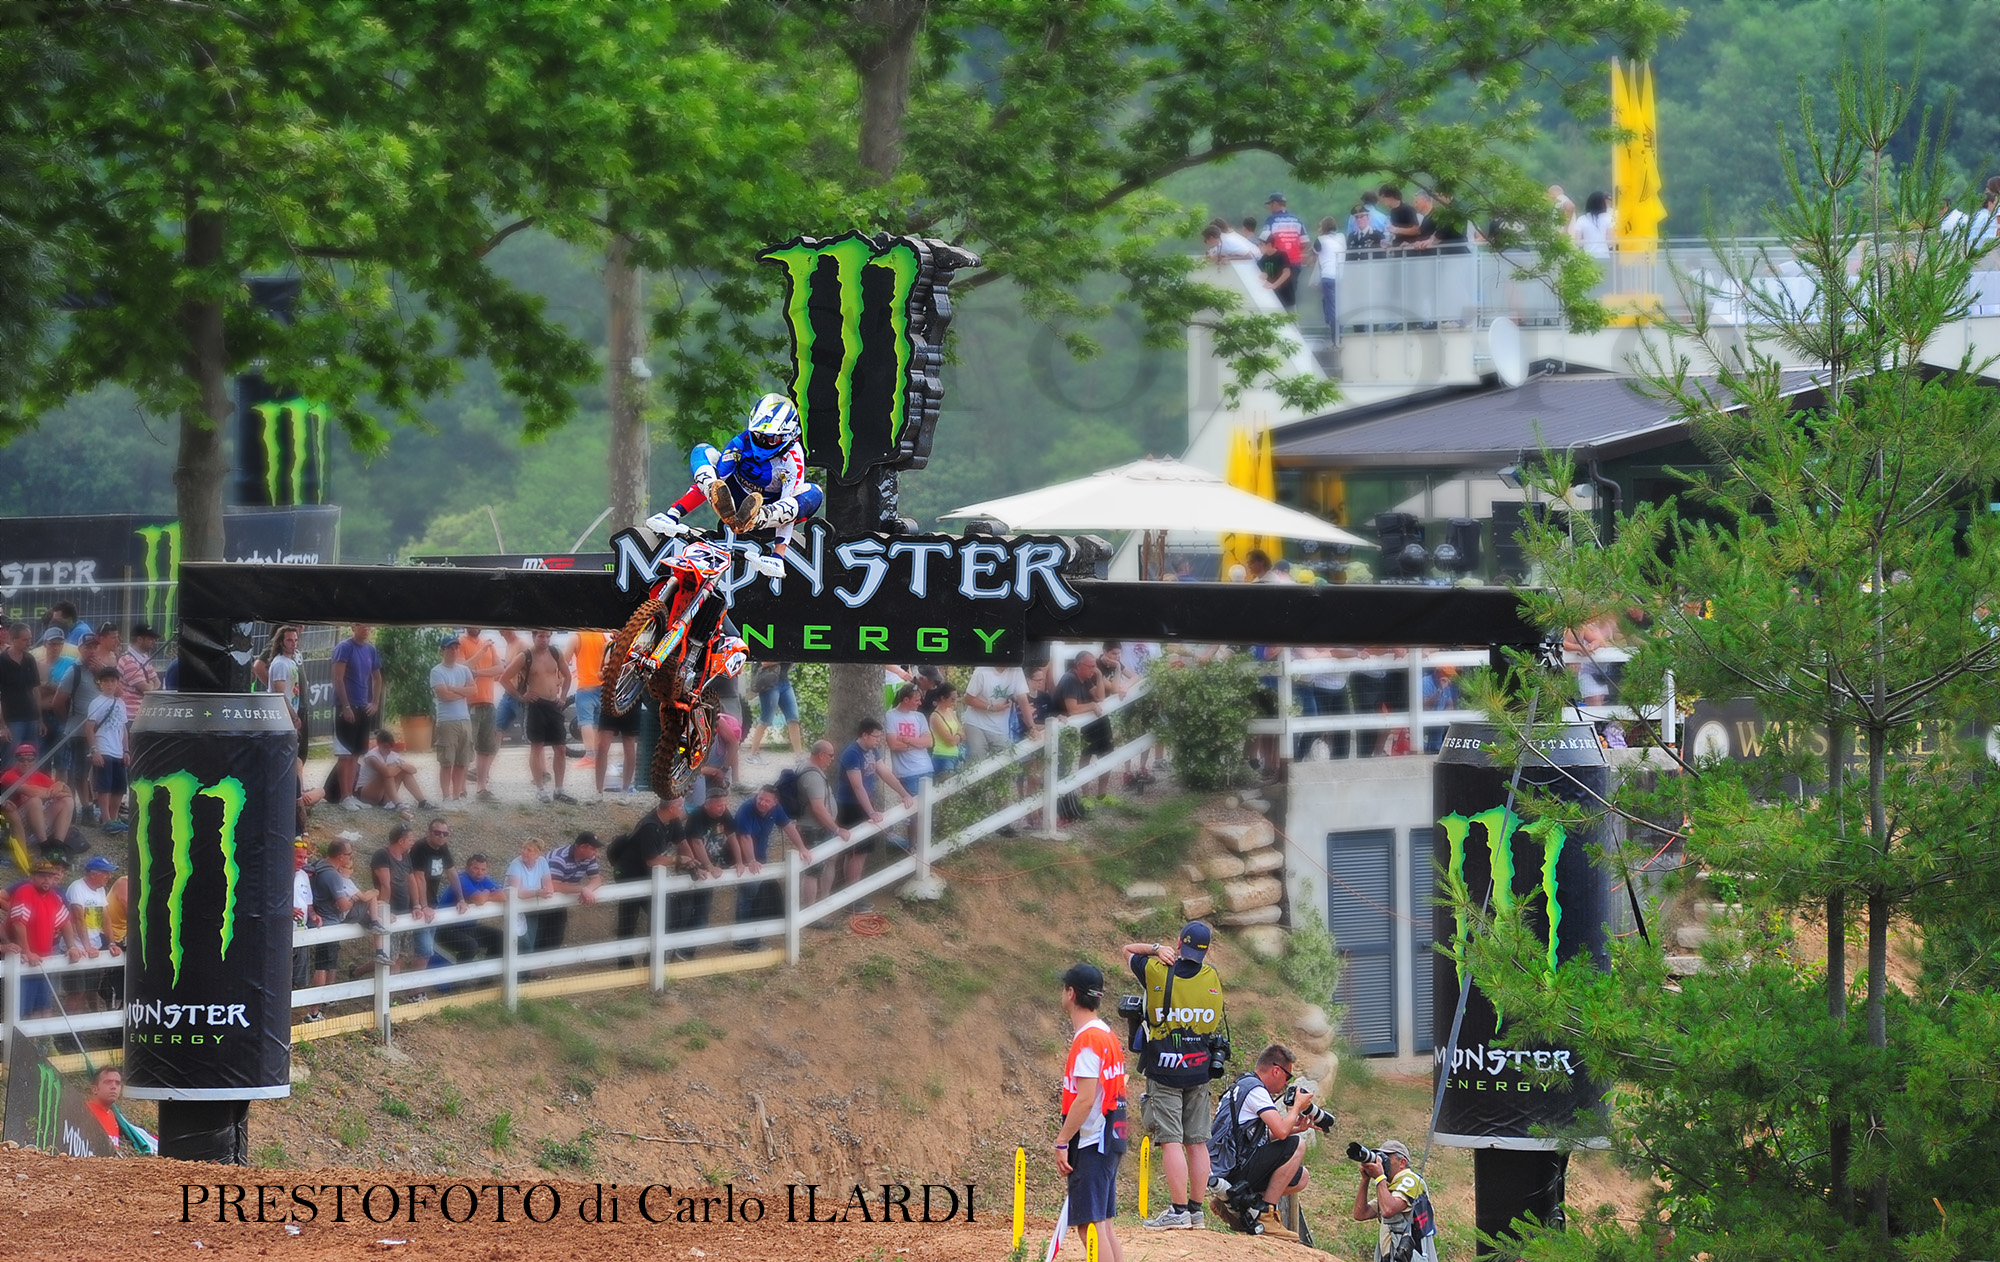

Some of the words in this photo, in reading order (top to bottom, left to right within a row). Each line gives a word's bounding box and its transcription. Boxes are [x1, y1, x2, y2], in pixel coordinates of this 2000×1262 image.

[222, 706, 282, 720] TAURINE
[129, 1033, 225, 1045] ENERGY
[63, 1119, 94, 1158] MON
